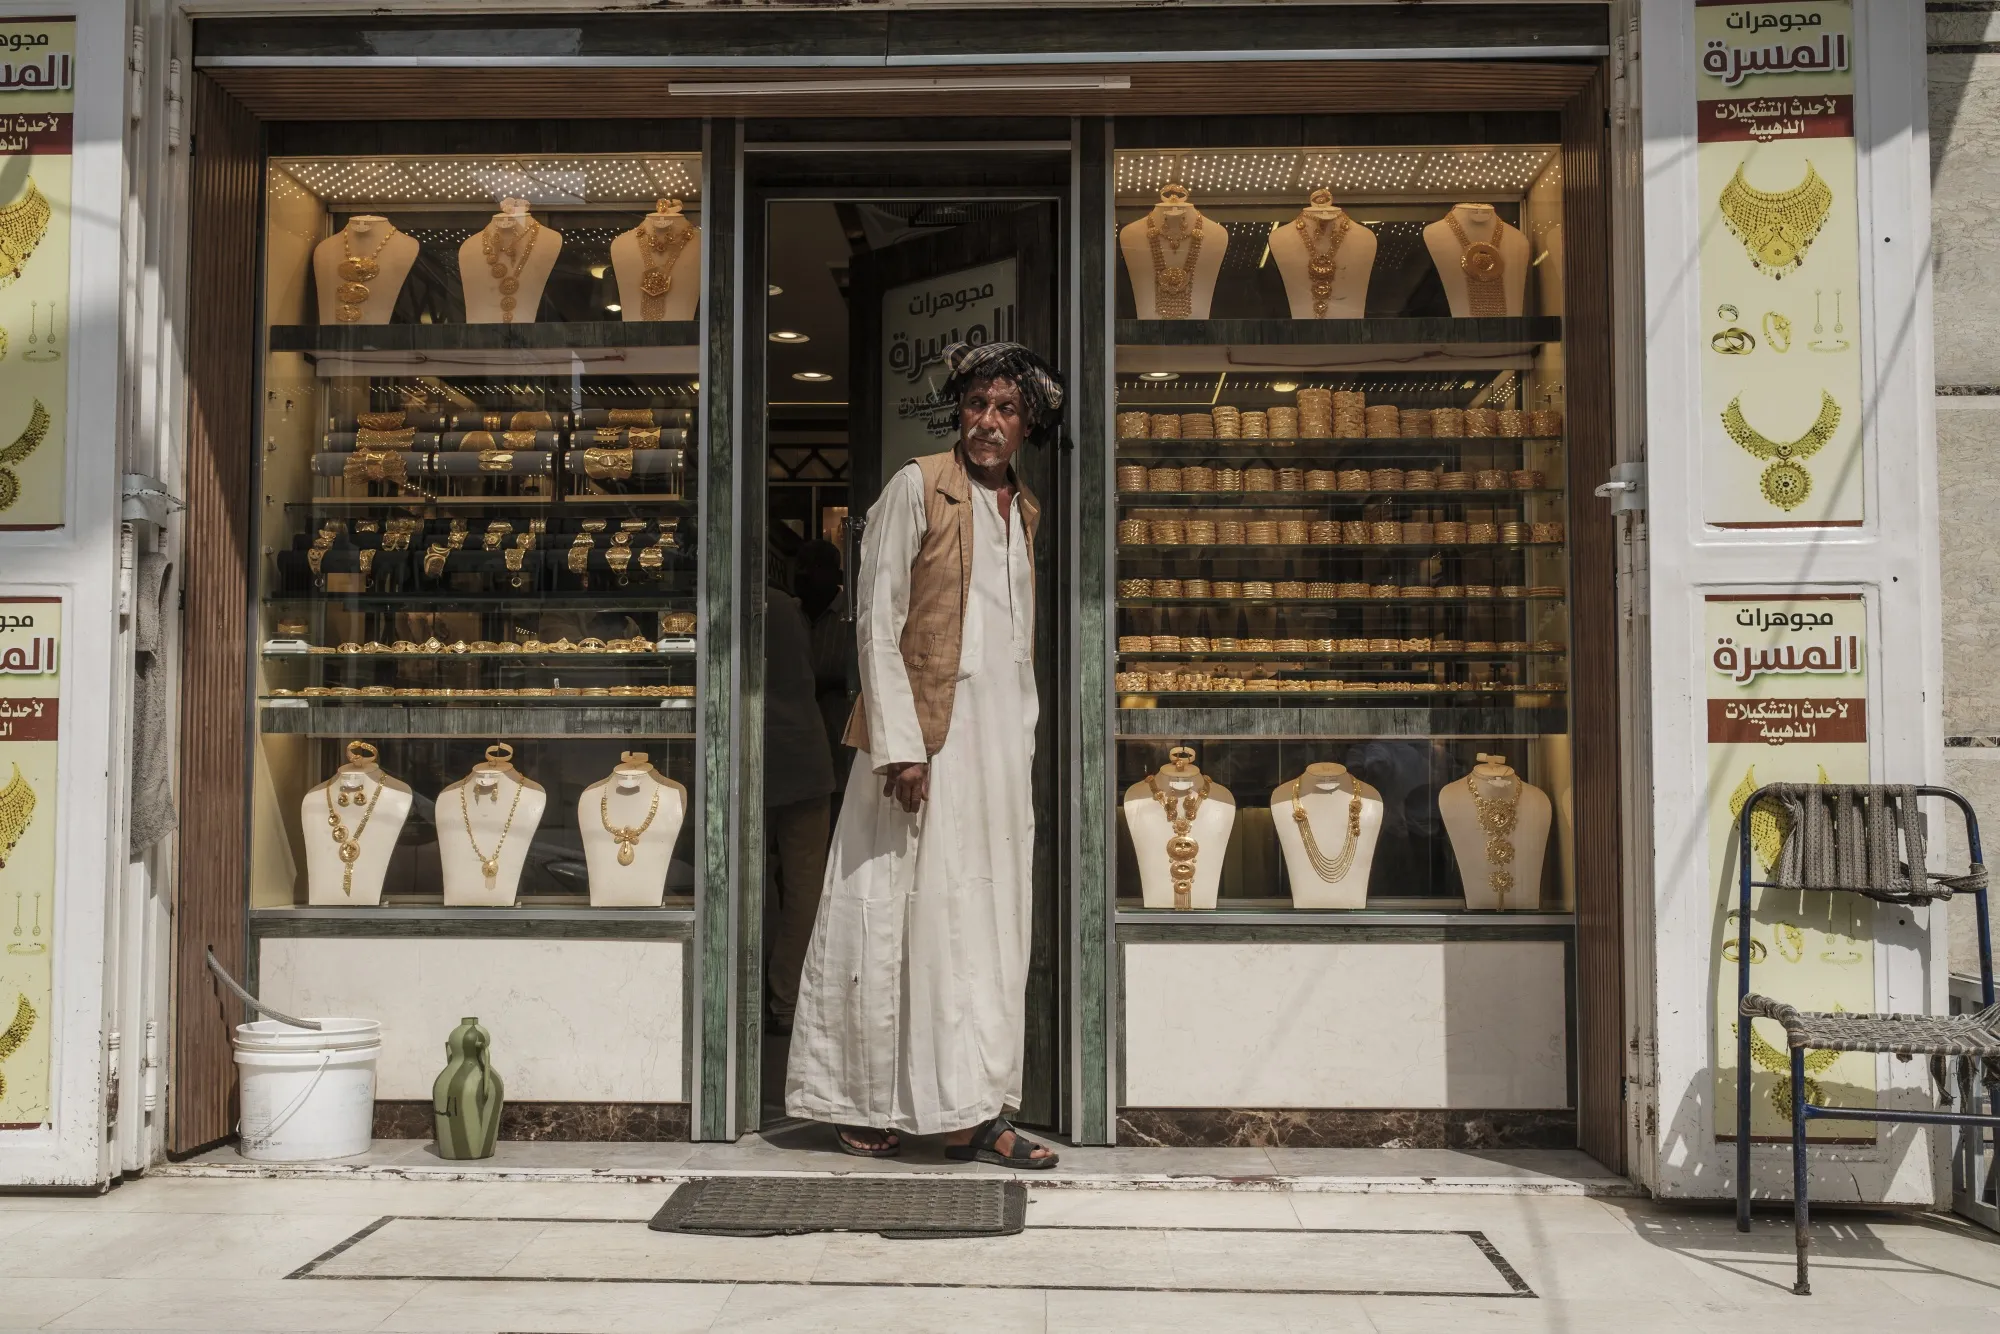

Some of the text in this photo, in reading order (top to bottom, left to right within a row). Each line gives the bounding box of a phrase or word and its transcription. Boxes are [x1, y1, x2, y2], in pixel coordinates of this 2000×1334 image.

[1726, 11, 1821, 34] مجوهرات
[1703, 34, 1844, 83] المسرة
[1715, 97, 1836, 123] لأحدث التشكيلات
[15, 115, 59, 132] لأحدث
[1748, 118, 1805, 140] الذهبية
[908, 282, 994, 319] مجوهرات
[1736, 608, 1834, 632] مجوهرات
[1713, 635, 1857, 682] المسرة
[0, 699, 44, 718] لأحدث
[1725, 700, 1849, 724] لأحدث التشكيلات
[1759, 720, 1816, 742] الذهبية
